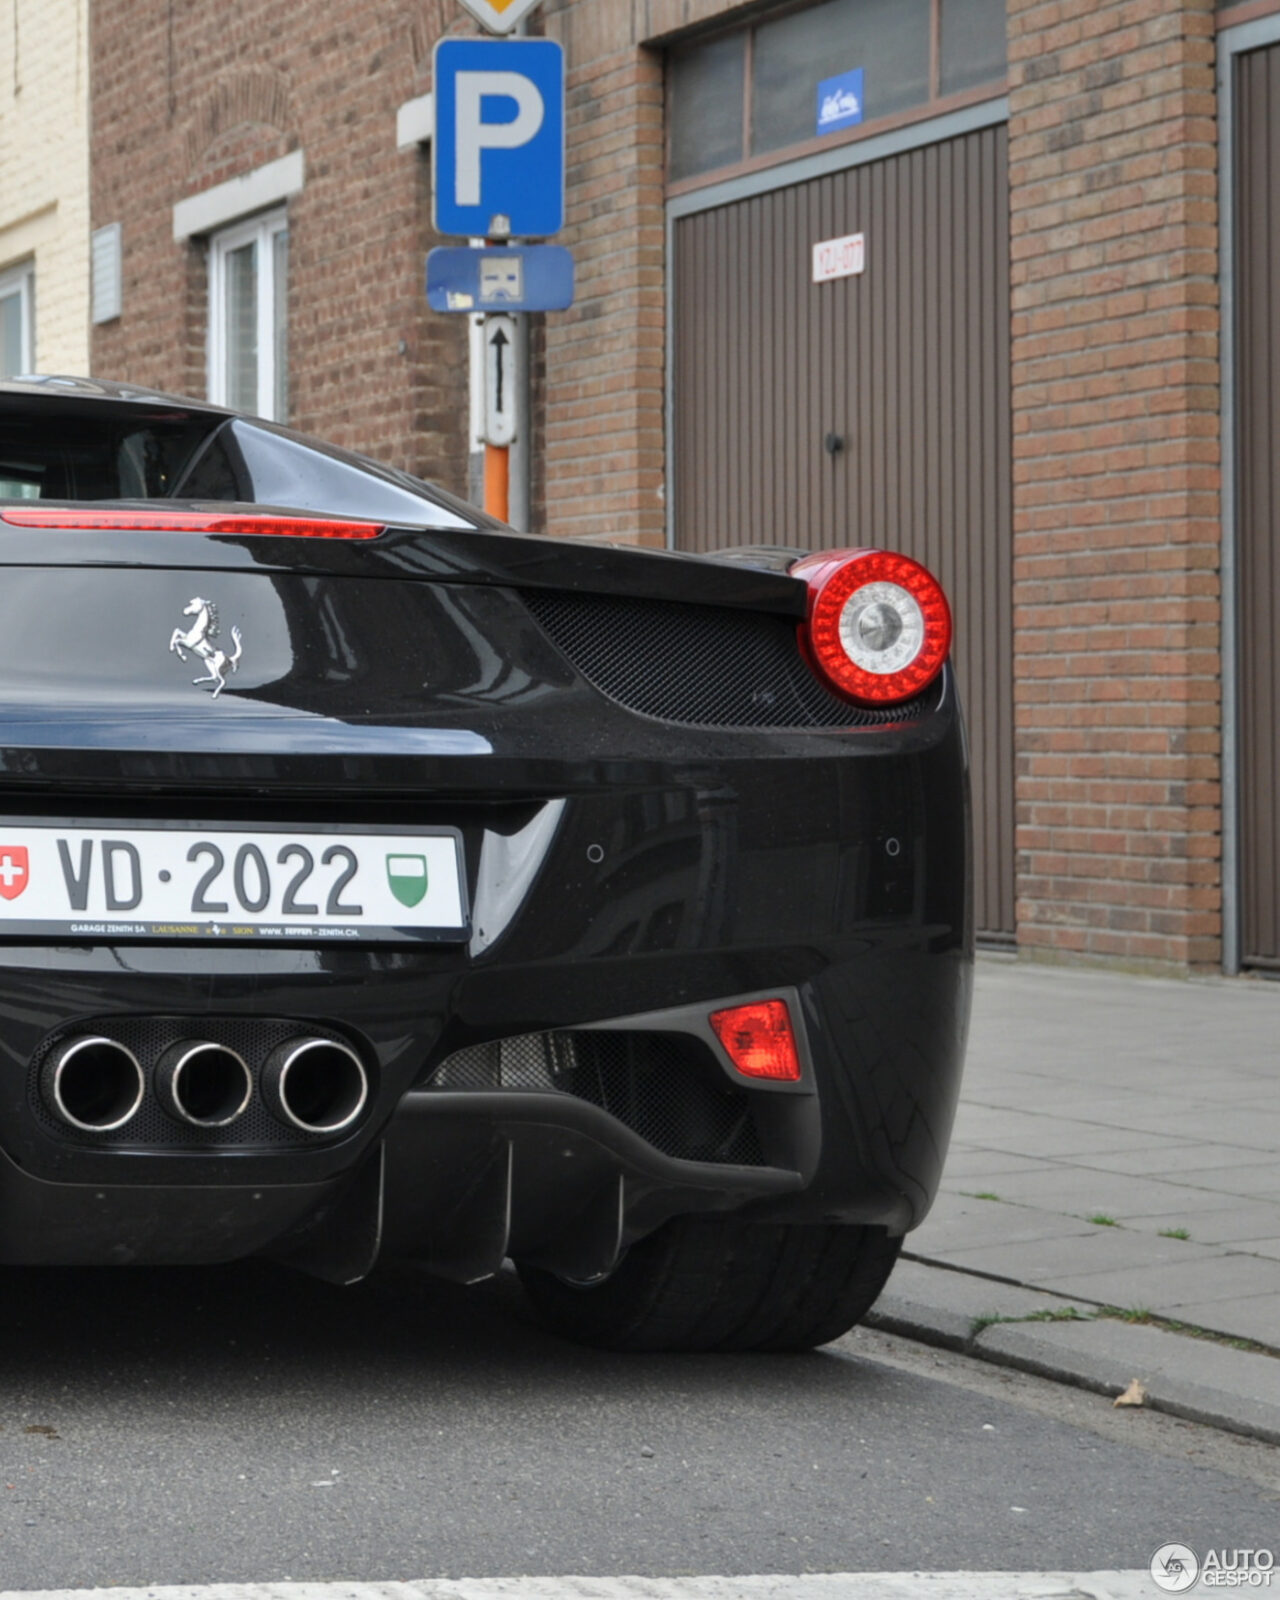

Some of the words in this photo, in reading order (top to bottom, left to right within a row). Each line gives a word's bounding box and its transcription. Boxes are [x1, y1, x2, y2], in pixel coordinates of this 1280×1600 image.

[455, 70, 545, 206] P
[70, 924, 106, 933] GARAGE
[106, 924, 133, 933] ZENITH
[134, 925, 146, 933] SA
[151, 925, 199, 934] LAUSANNE
[233, 926, 255, 935] SION
